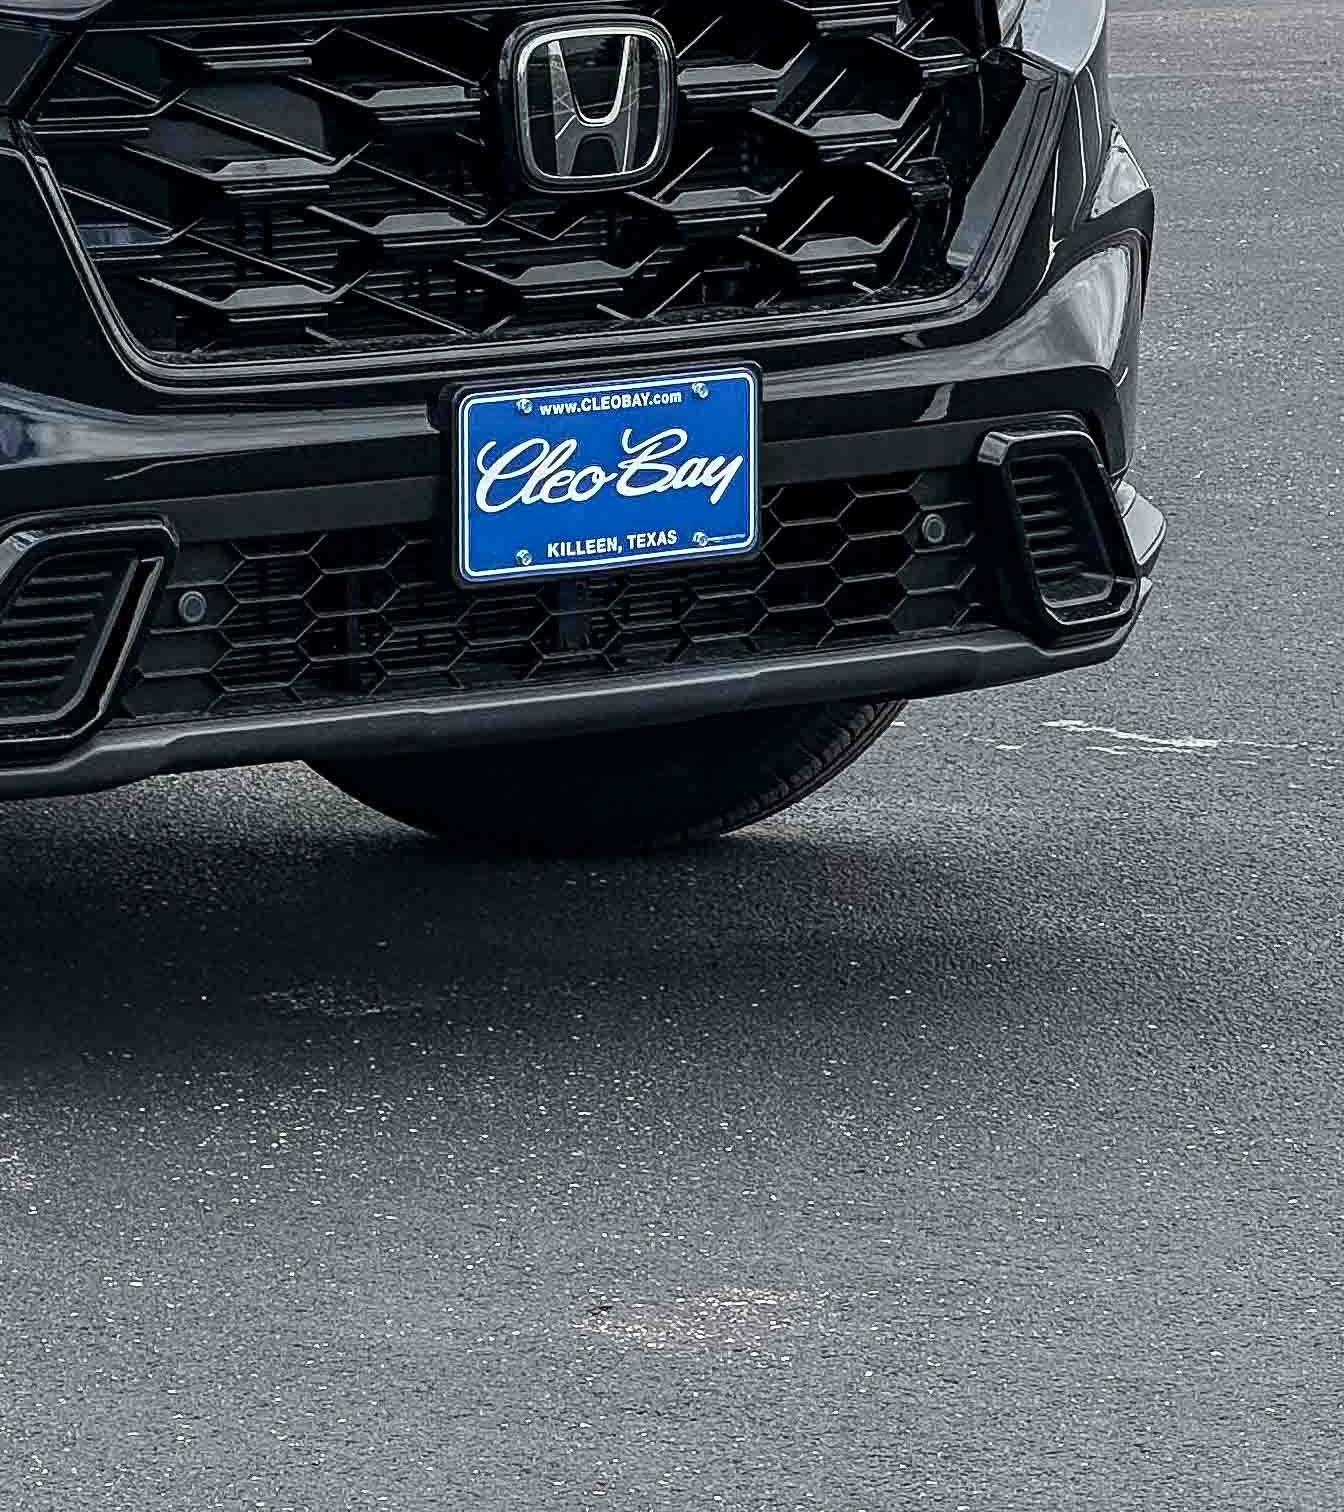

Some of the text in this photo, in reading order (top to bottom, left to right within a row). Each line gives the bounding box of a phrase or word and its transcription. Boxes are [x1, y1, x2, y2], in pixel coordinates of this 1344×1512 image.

[539, 391, 682, 416] www.CLEOBAY.com
[475, 428, 744, 513] Cleo Bay
[547, 529, 678, 558] KILLEEN, TEXAS
